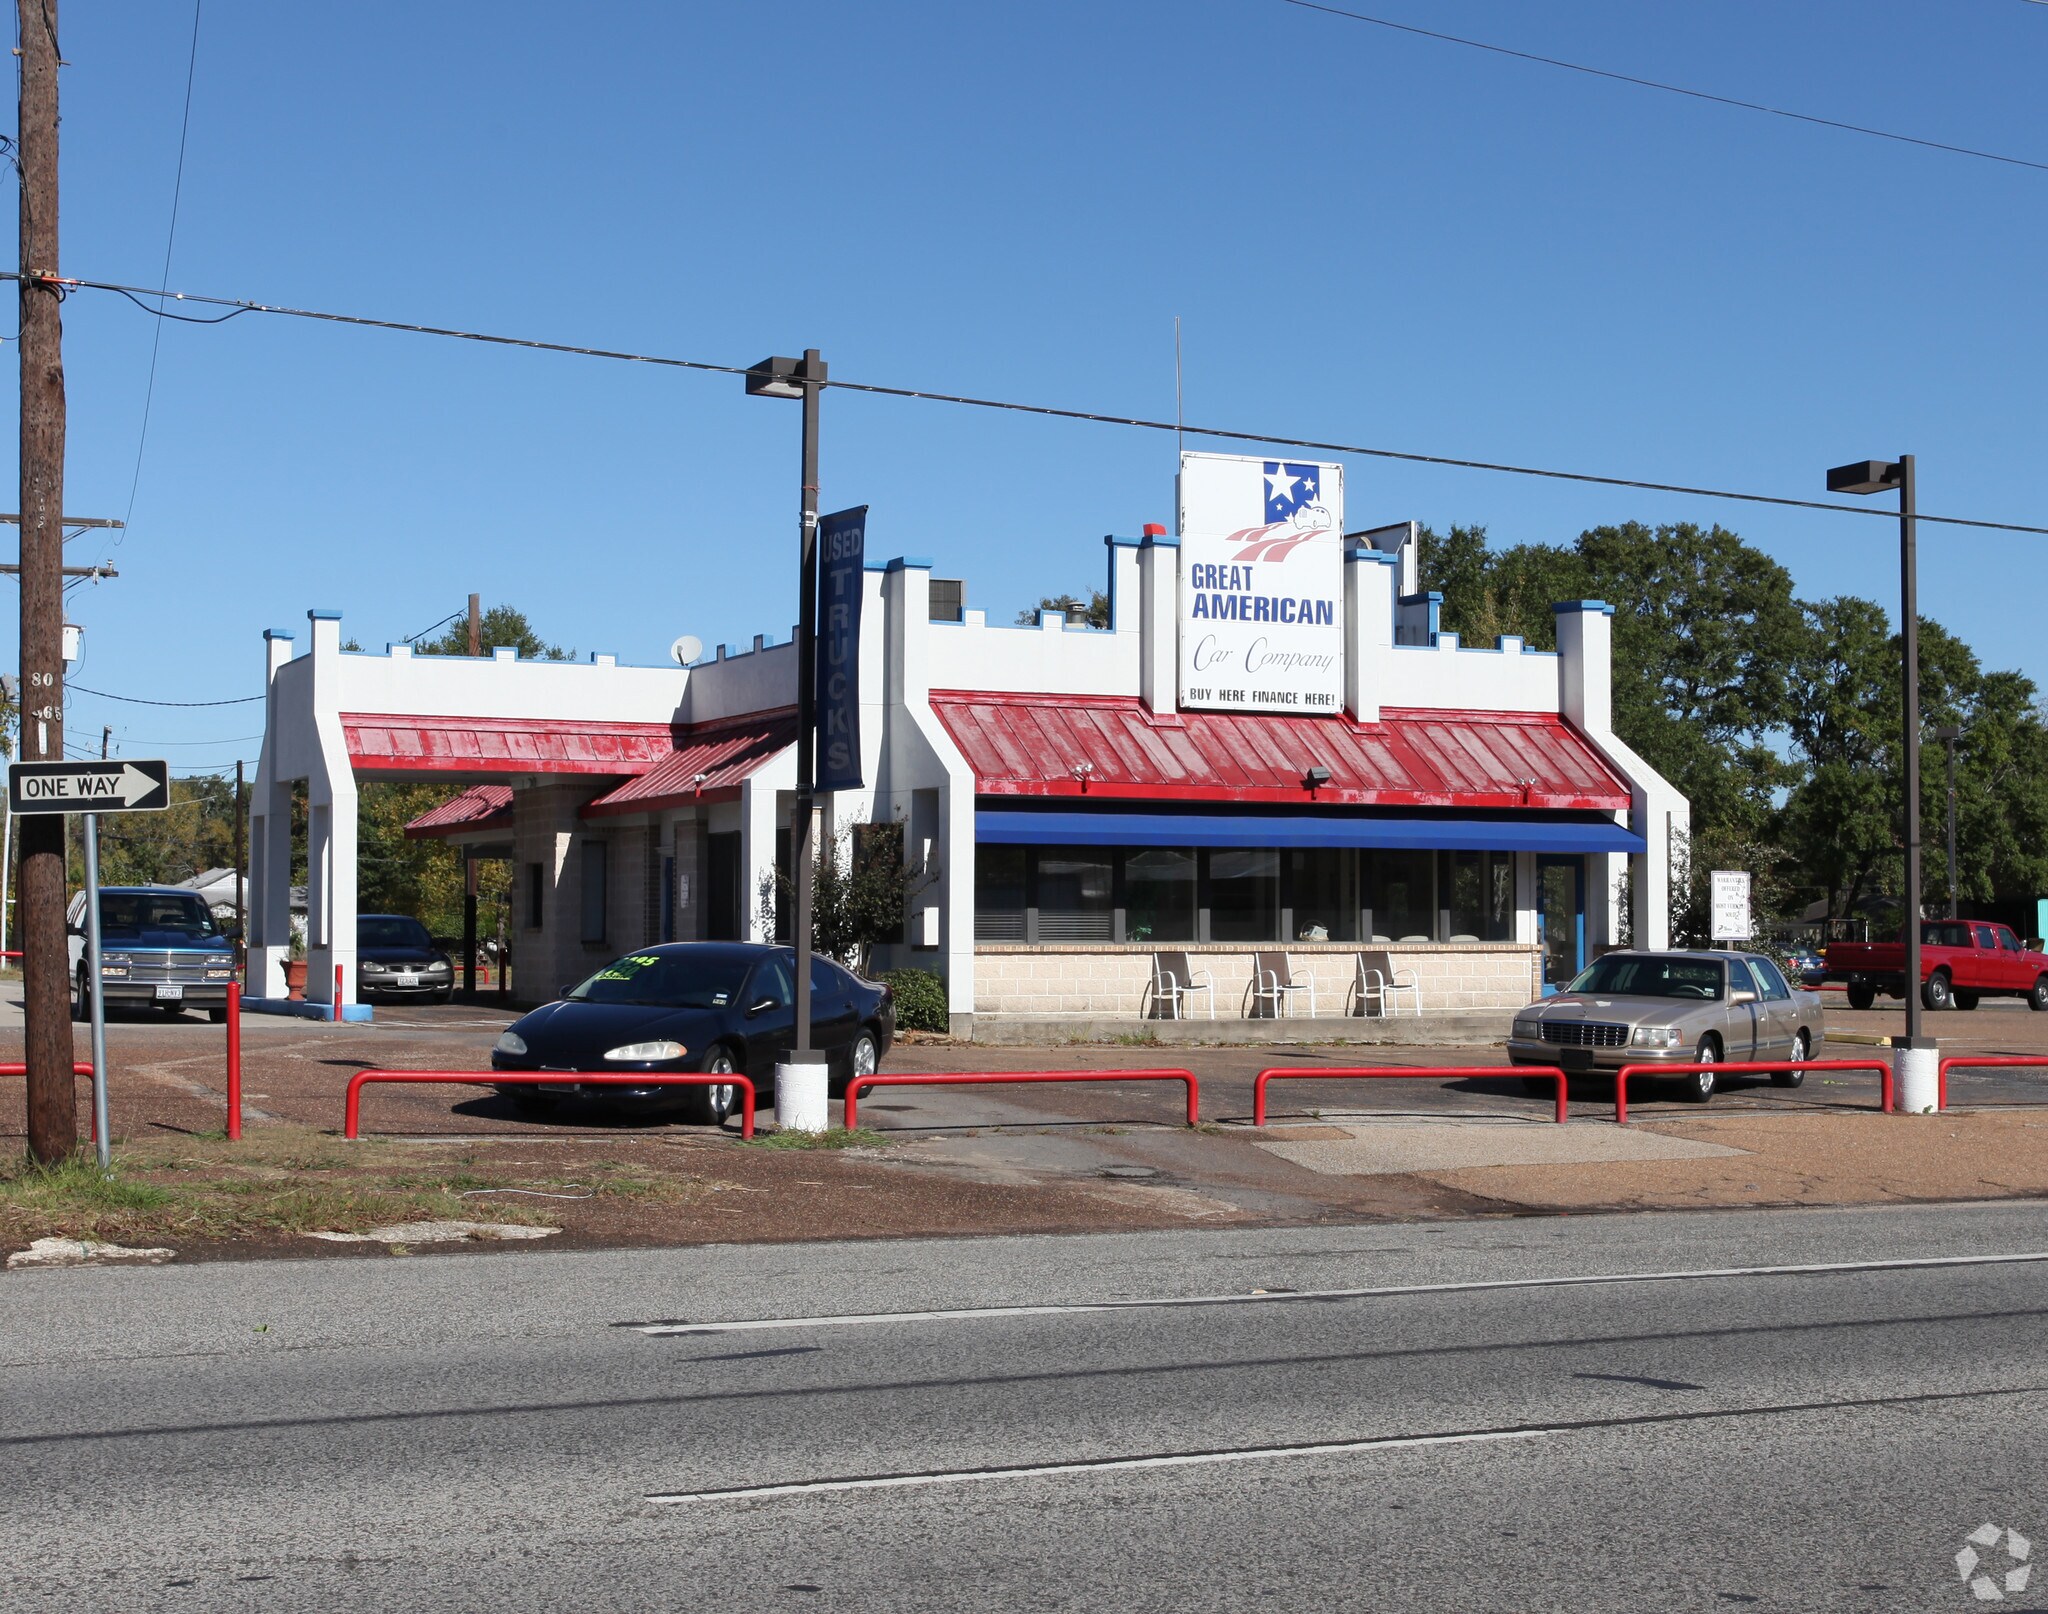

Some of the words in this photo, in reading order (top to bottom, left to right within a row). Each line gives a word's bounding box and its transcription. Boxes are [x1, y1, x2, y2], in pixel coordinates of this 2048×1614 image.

[823, 528, 861, 563] USED
[1192, 563, 1253, 591] GREAT
[1192, 593, 1333, 625] AMERICAN
[1194, 634, 1234, 672] Car
[1245, 636, 1334, 673] Company
[31, 672, 54, 687] 80
[826, 569, 852, 770] TRUCKS
[1190, 688, 1212, 701] BUY
[1219, 689, 1246, 703] HERE
[1253, 691, 1298, 704] FINANCE
[1305, 692, 1335, 706] HERE!
[26, 778, 69, 798] ONE
[77, 776, 120, 796] WAY
